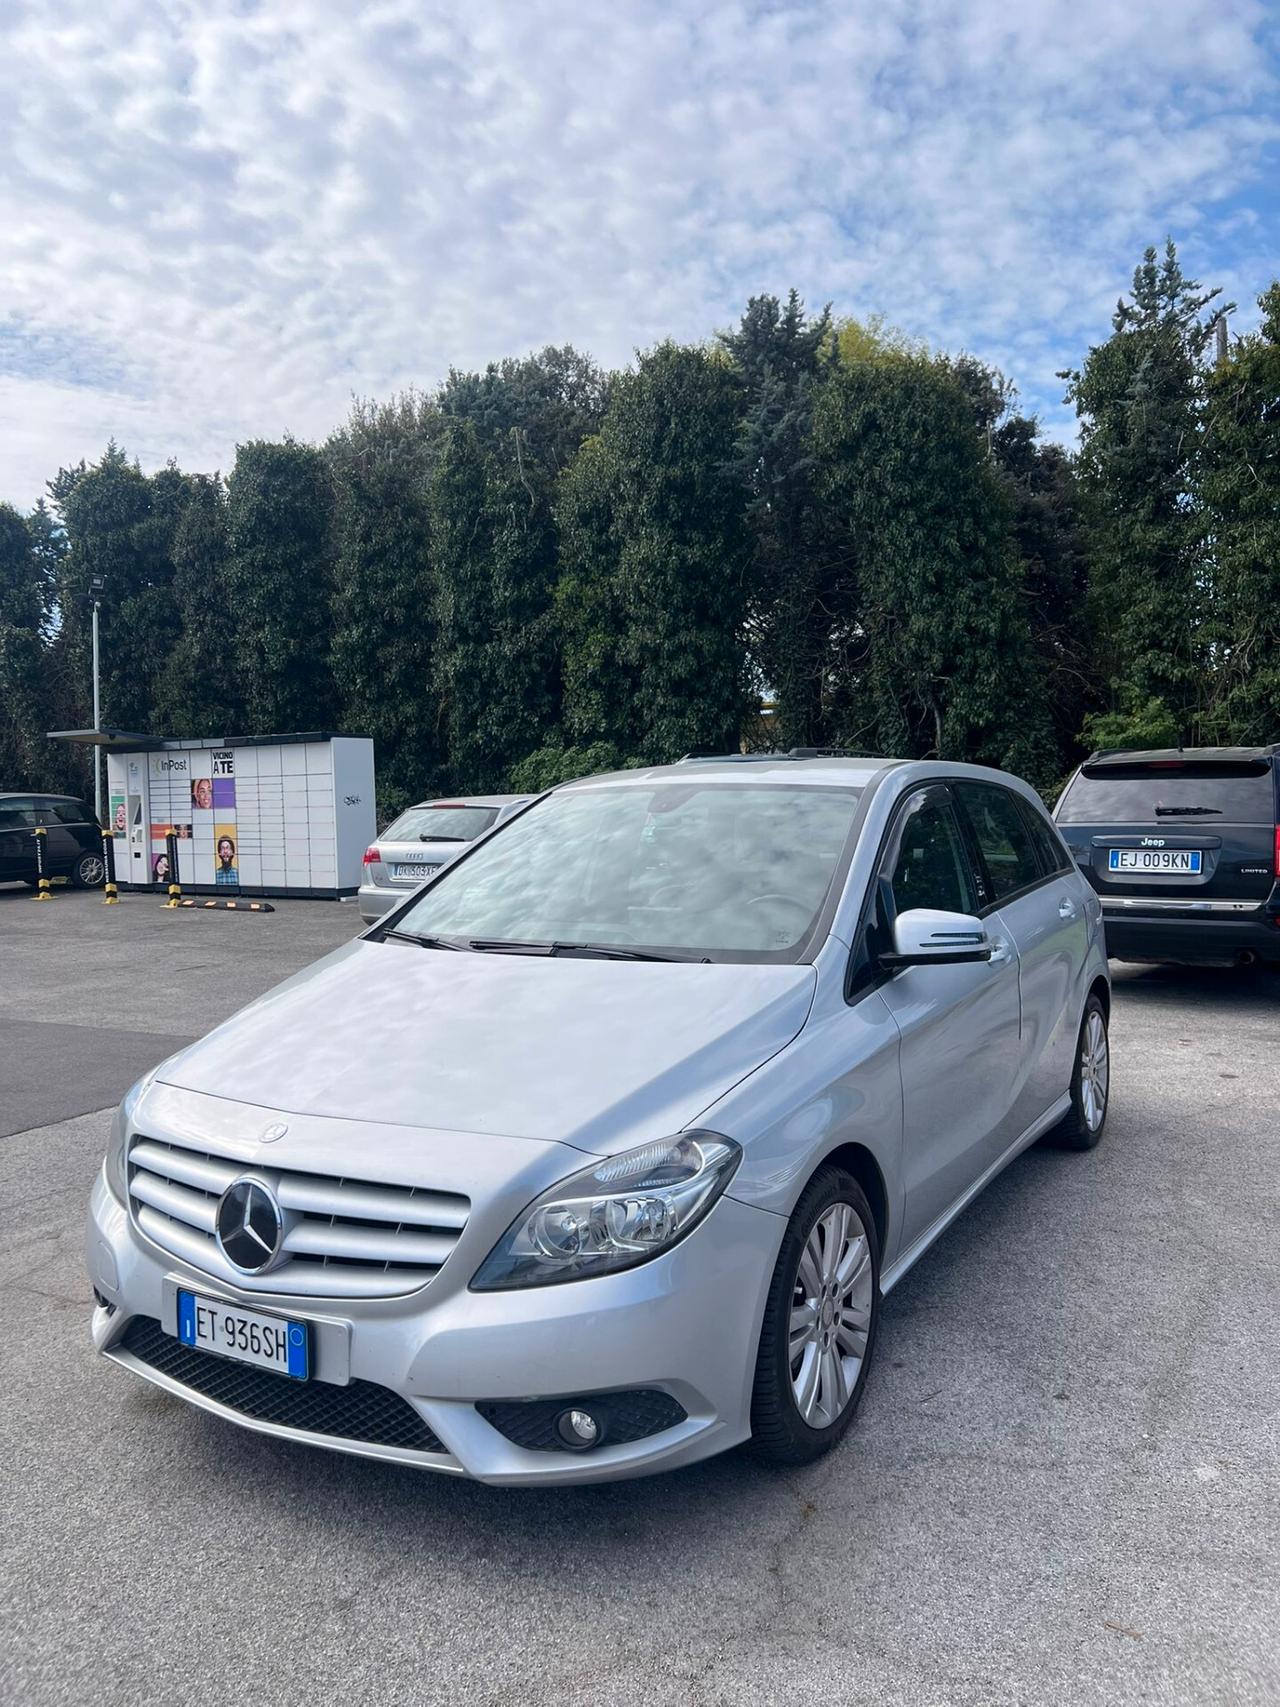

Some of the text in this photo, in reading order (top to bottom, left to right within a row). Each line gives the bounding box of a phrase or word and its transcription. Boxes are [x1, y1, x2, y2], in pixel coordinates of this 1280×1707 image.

[212, 752, 234, 760] VICINO
[161, 759, 187, 771] InPost
[213, 760, 234, 774] A TE
[1140, 837, 1165, 847] Jeep
[1120, 853, 1190, 868] EJ 009KN
[196, 1306, 287, 1363] ET 936SH
